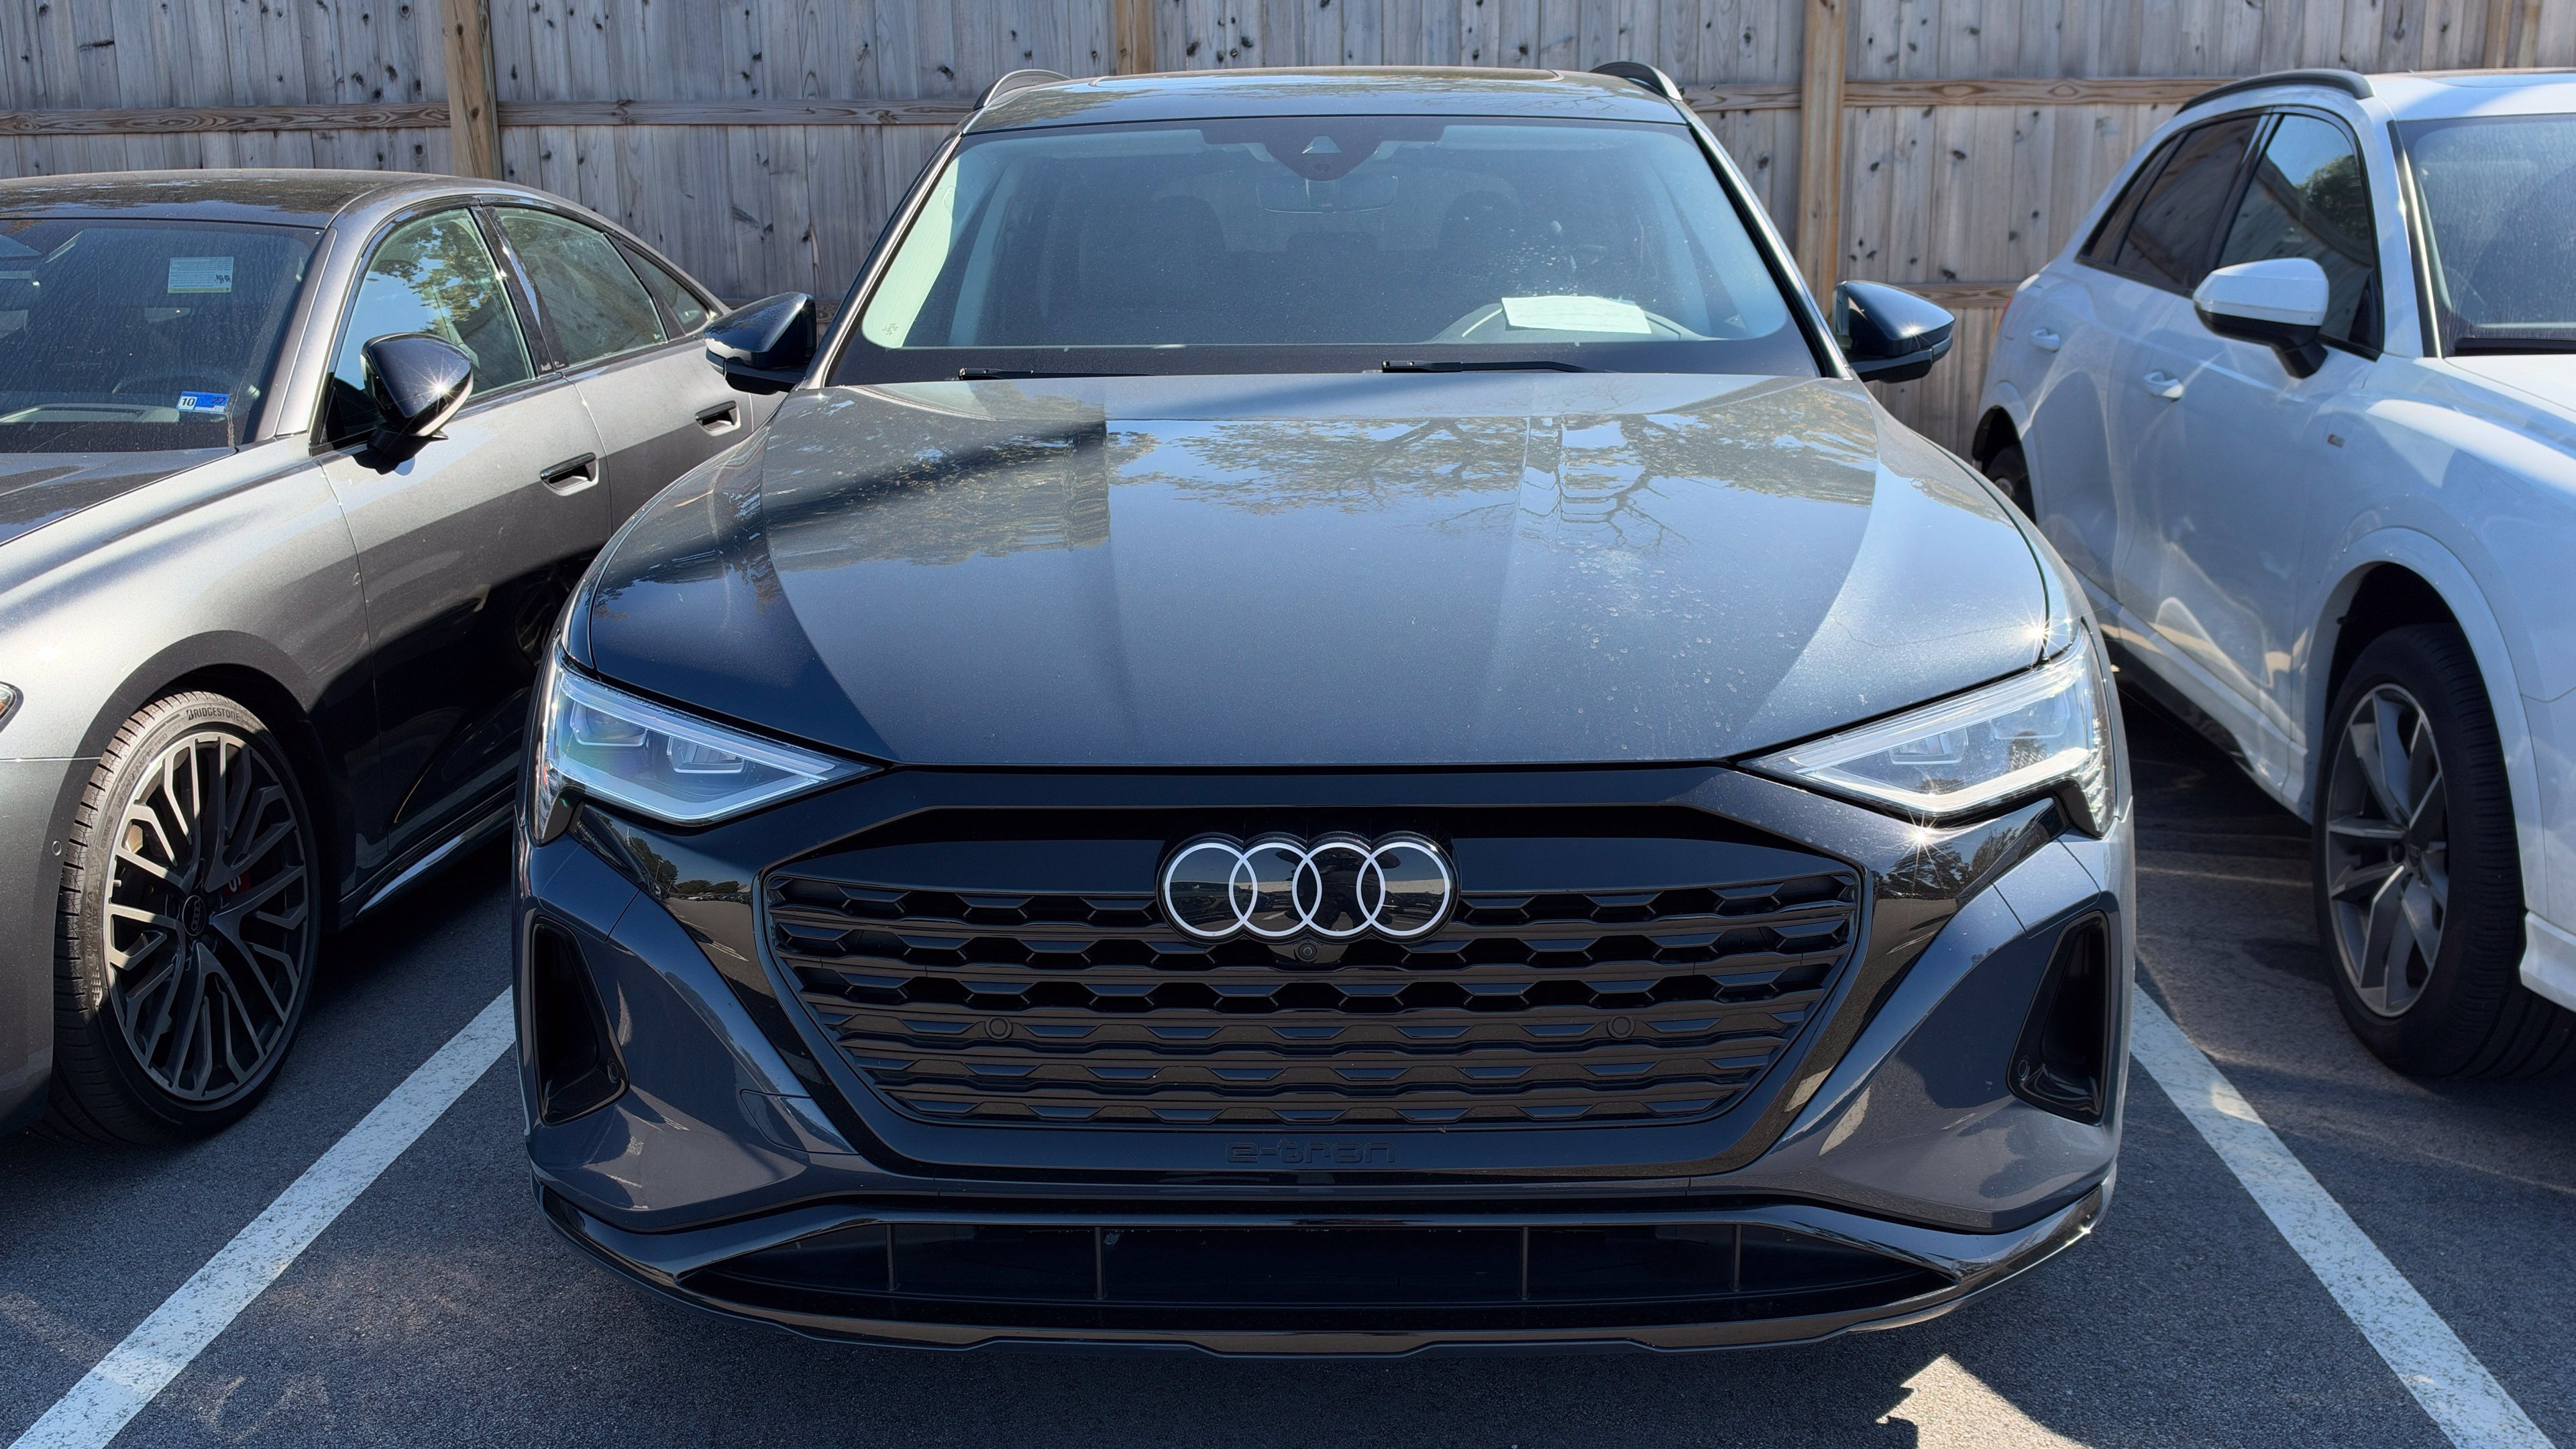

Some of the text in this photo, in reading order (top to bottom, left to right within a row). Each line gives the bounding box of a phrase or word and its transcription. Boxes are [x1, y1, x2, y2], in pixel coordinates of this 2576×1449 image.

[182, 396, 226, 407] 10 27
[186, 707, 241, 722] BRIDGESTONE
[1224, 1138, 1396, 1164] e-tron
